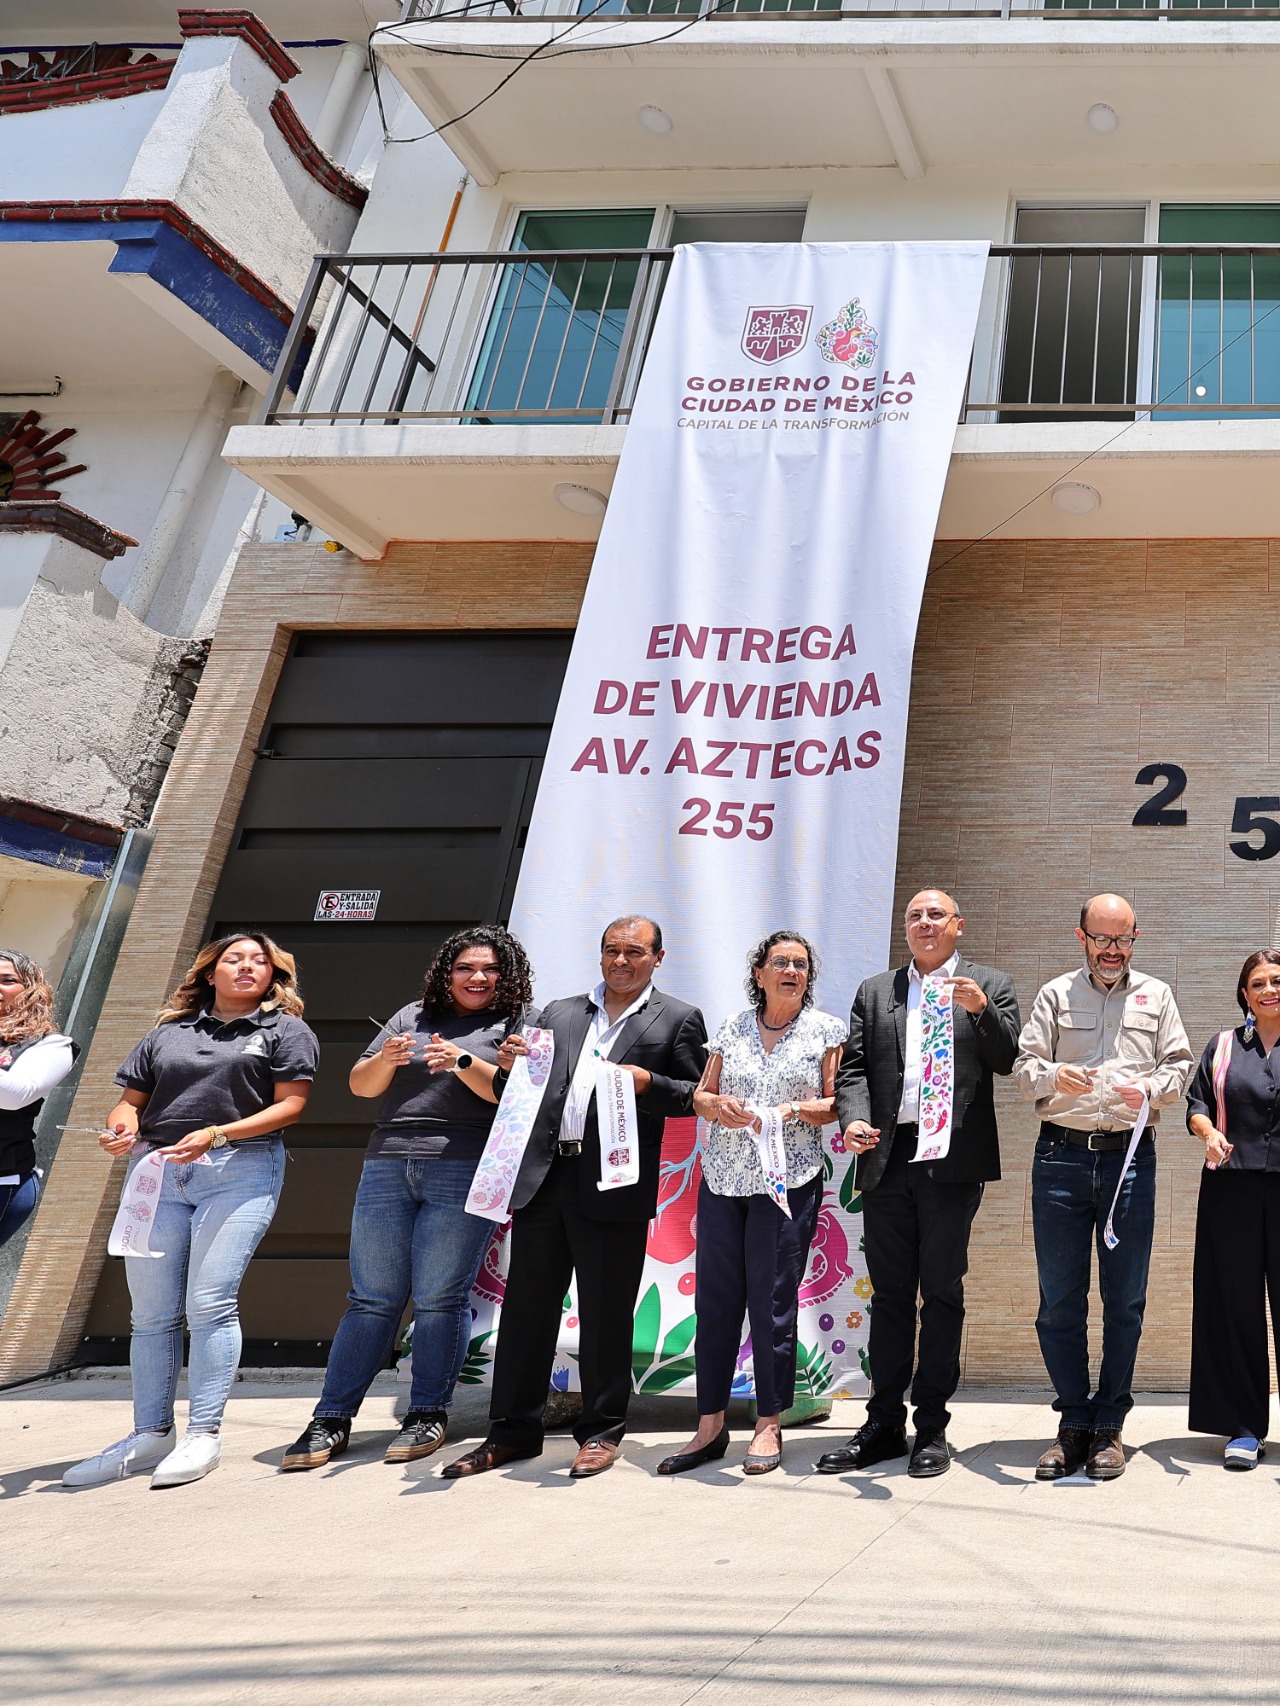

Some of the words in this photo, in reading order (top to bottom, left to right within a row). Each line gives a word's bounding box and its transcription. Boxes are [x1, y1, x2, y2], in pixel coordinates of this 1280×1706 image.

[686, 375, 831, 393] GOBIERNO
[841, 375, 877, 392] DE
[882, 370, 916, 385] LA
[681, 396, 776, 413] CIUDAD
[784, 398, 817, 413] DE
[823, 390, 913, 413] MÉXICO
[677, 417, 735, 430] CAPITAL
[738, 419, 758, 430] DE
[762, 418, 778, 429] LA
[783, 409, 910, 430] TRANSFORMACIÓN
[646, 623, 857, 664] ENTREGA
[593, 679, 660, 716] DE
[671, 671, 882, 721] VIVIENDA
[569, 736, 651, 776] AV.
[664, 730, 882, 779] AZTECAS
[678, 797, 775, 841] 255
[340, 893, 376, 901] ENTRADA
[614, 1069, 624, 1099] CIUDAD
[616, 1099, 625, 1111] DE
[617, 1112, 628, 1142] MÉXICO
